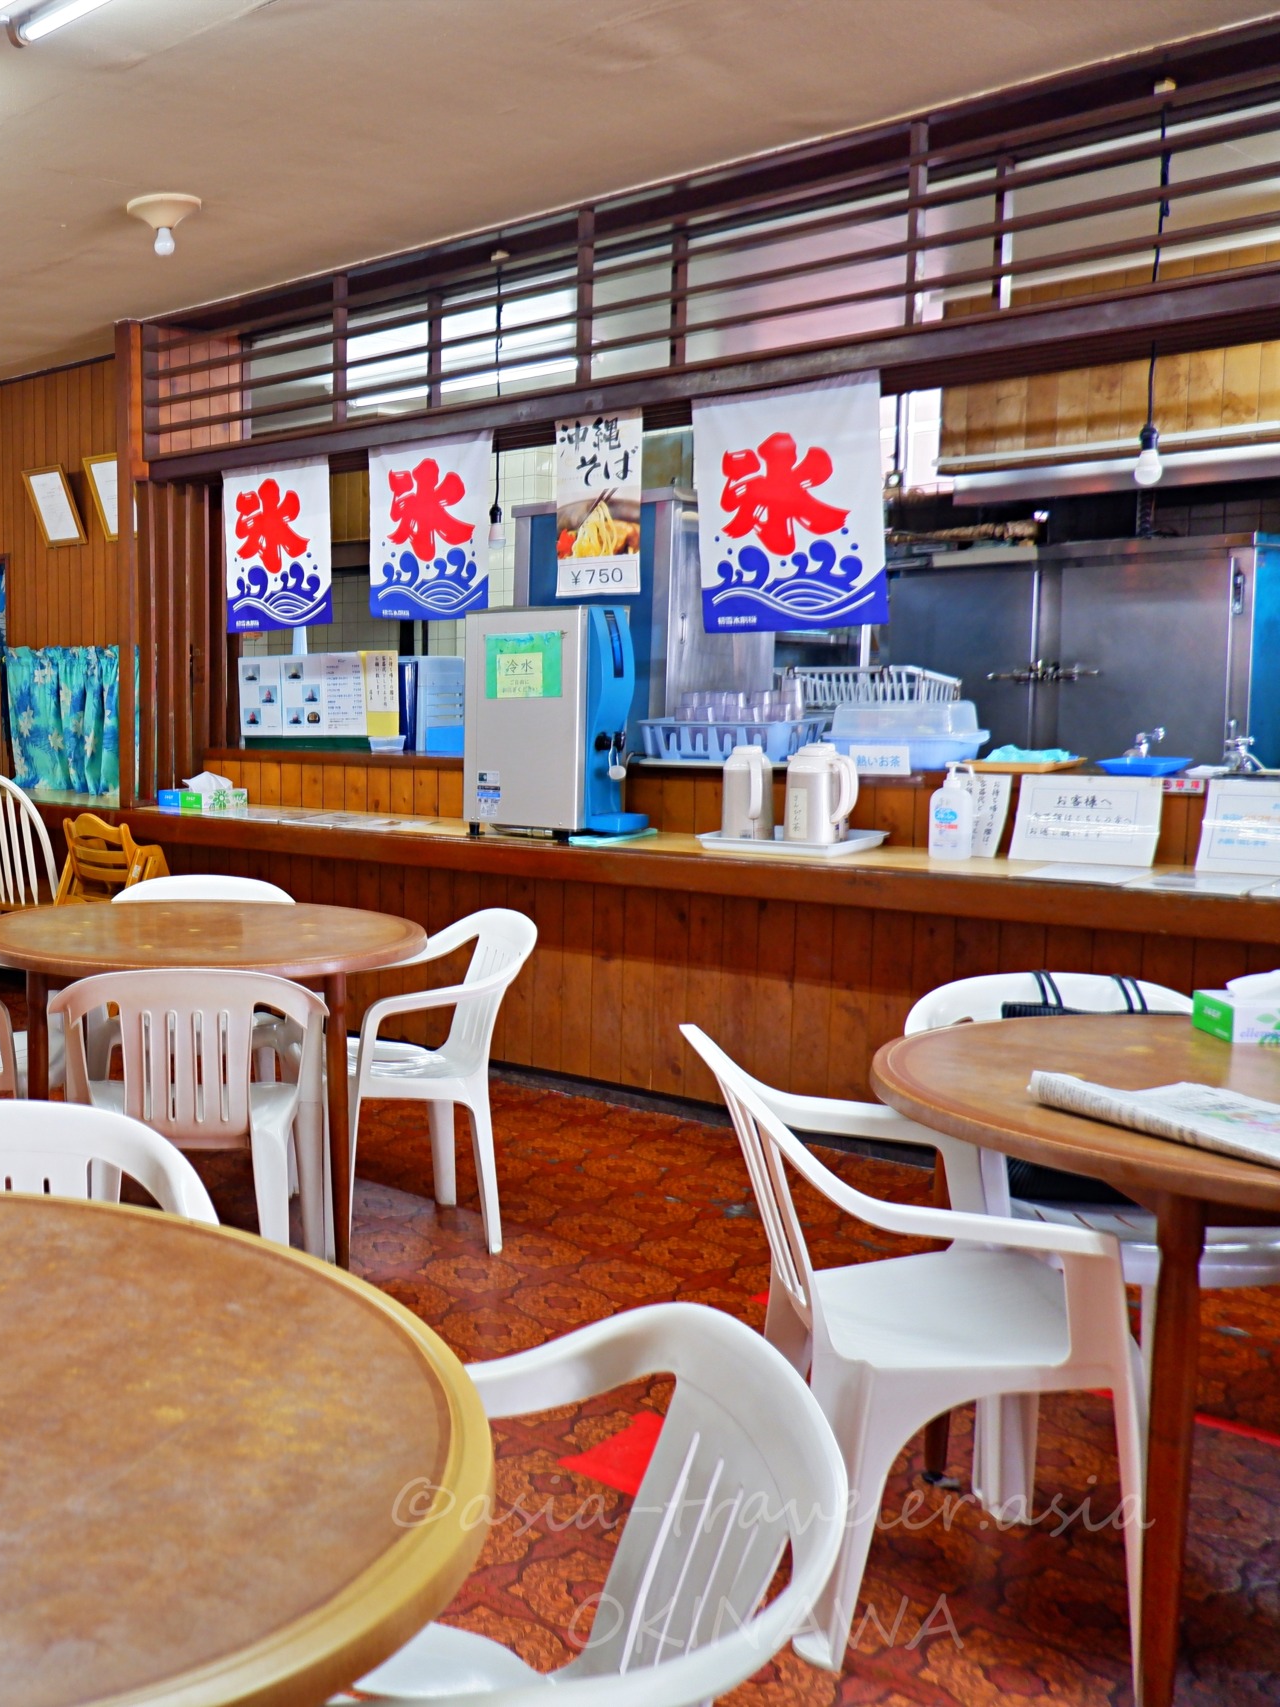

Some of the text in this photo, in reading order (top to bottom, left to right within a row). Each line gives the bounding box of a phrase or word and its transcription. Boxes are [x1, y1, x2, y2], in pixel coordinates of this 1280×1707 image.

[559, 416, 622, 457] 沖縄
[576, 446, 639, 486] そば
[387, 458, 476, 562] 氷
[720, 432, 852, 556] 氷
[236, 478, 310, 574] 氷
[571, 567, 624, 585] ¥750
[506, 659, 534, 673] 冷水
[856, 755, 901, 767] 熱いお茶
[1056, 794, 1113, 808] お客様へ
